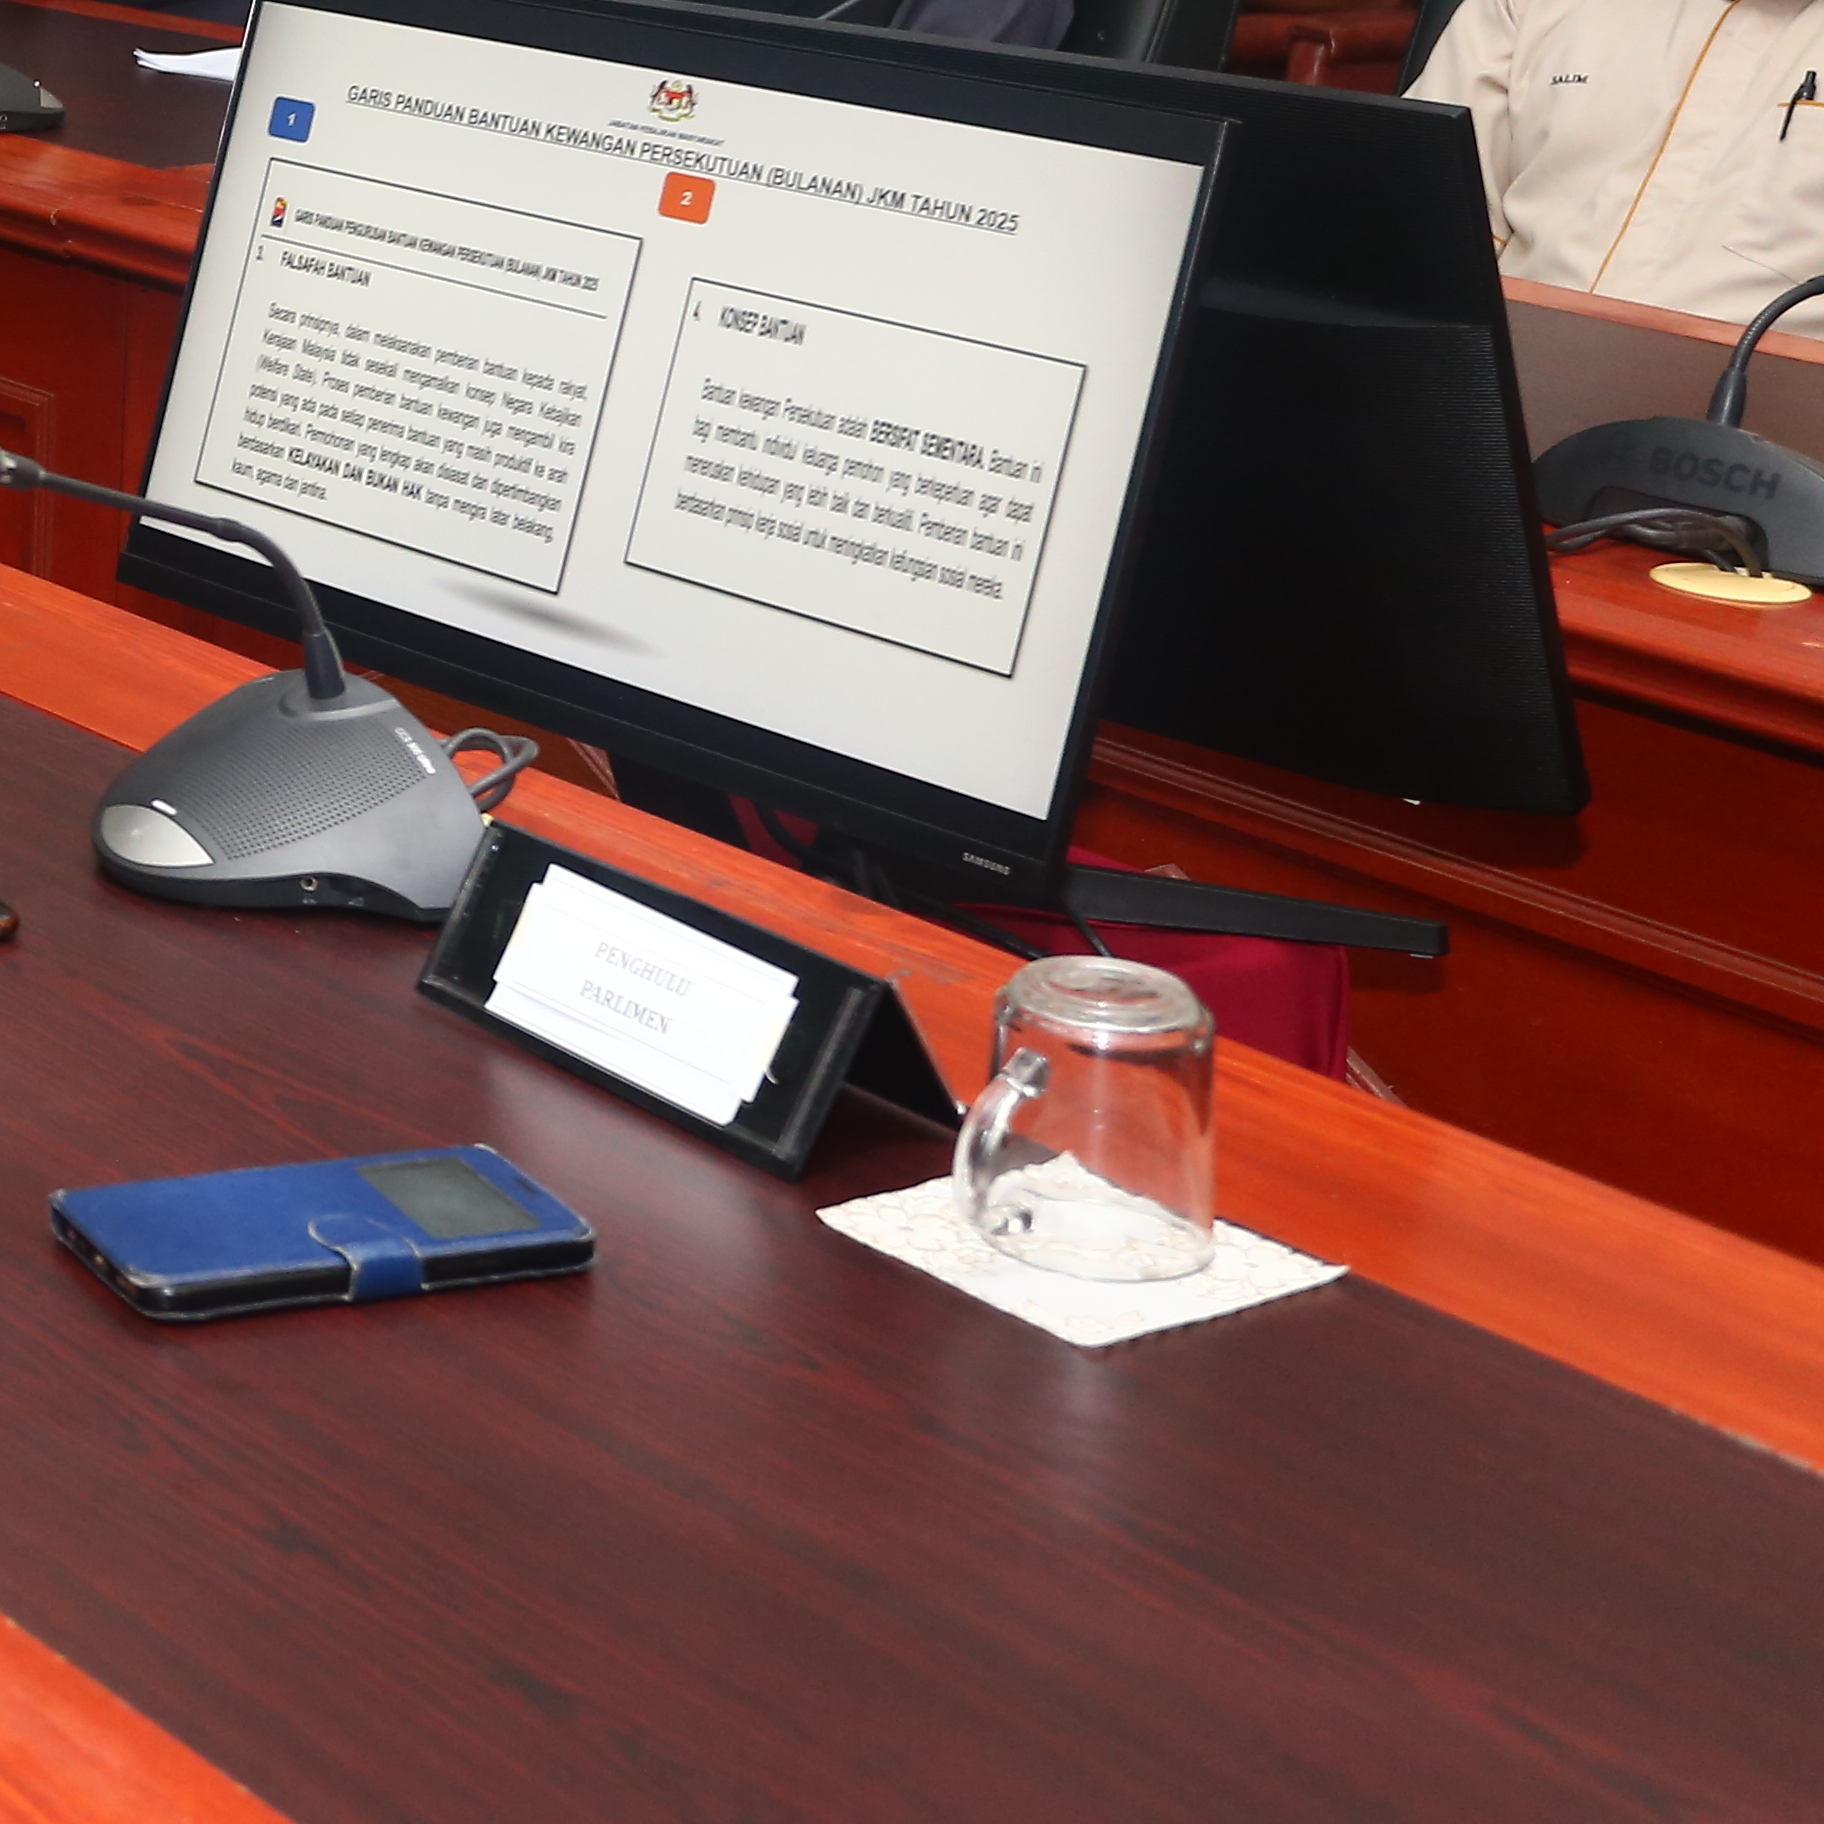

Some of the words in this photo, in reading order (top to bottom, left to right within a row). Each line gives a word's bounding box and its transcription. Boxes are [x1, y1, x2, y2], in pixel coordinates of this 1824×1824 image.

[1550, 74, 1590, 85] SALIM
[286, 111, 297, 127] 1
[347, 85, 393, 108] GARIS
[394, 94, 466, 122] PANDUAN
[467, 108, 542, 137] BANTUAN
[544, 124, 637, 156] KEWANGAN
[639, 142, 764, 181] PERSEKUTUAN
[766, 167, 863, 201] (BULANAN)
[866, 187, 907, 209] JKM
[911, 194, 973, 223] TAHUN
[975, 208, 1020, 232] 2025
[679, 189, 692, 206] 2
[280, 251, 327, 276] FALSAFAH
[326, 262, 371, 287] BANTUAN
[287, 446, 341, 476] KELAYAKAN
[342, 462, 365, 483] DAN
[365, 469, 400, 493] BUKAN
[401, 480, 424, 501] HAK
[1649, 446, 1781, 501] BOSCH
[962, 852, 1012, 875] SAMSUNG
[594, 940, 695, 998] PENGHULU
[579, 979, 674, 1034] PARLIMEN
